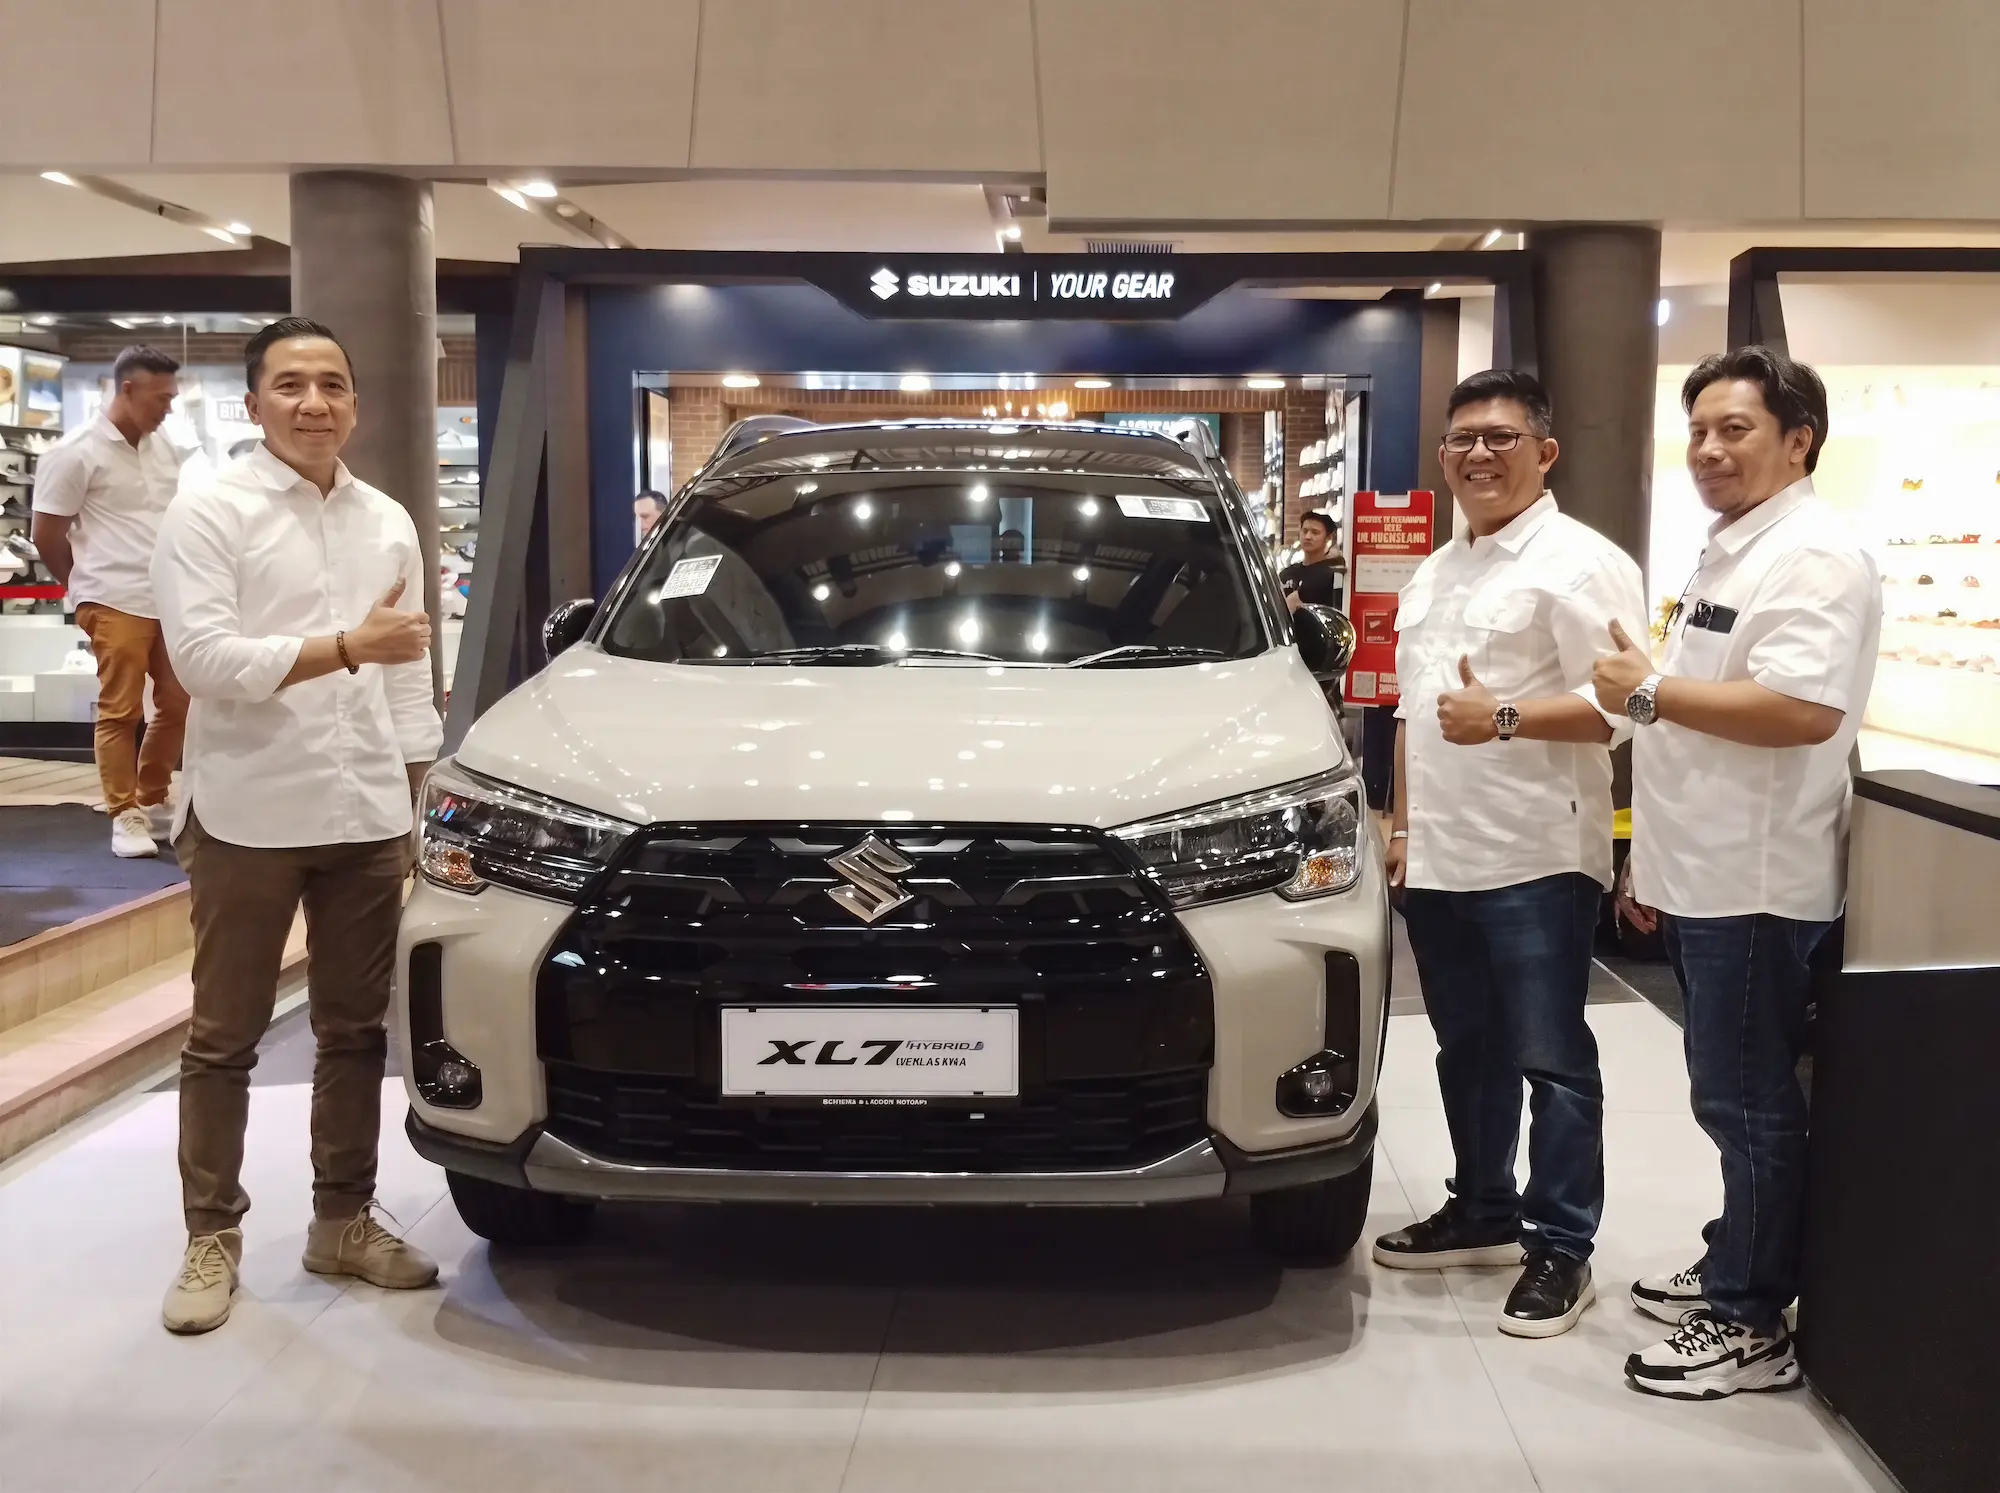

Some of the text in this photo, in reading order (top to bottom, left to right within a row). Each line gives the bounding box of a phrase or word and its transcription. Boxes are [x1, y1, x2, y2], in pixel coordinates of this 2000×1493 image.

[907, 273, 1175, 299] SUZUKI YOUR GEAR
[756, 1040, 970, 1066] XL7 HYBRID
